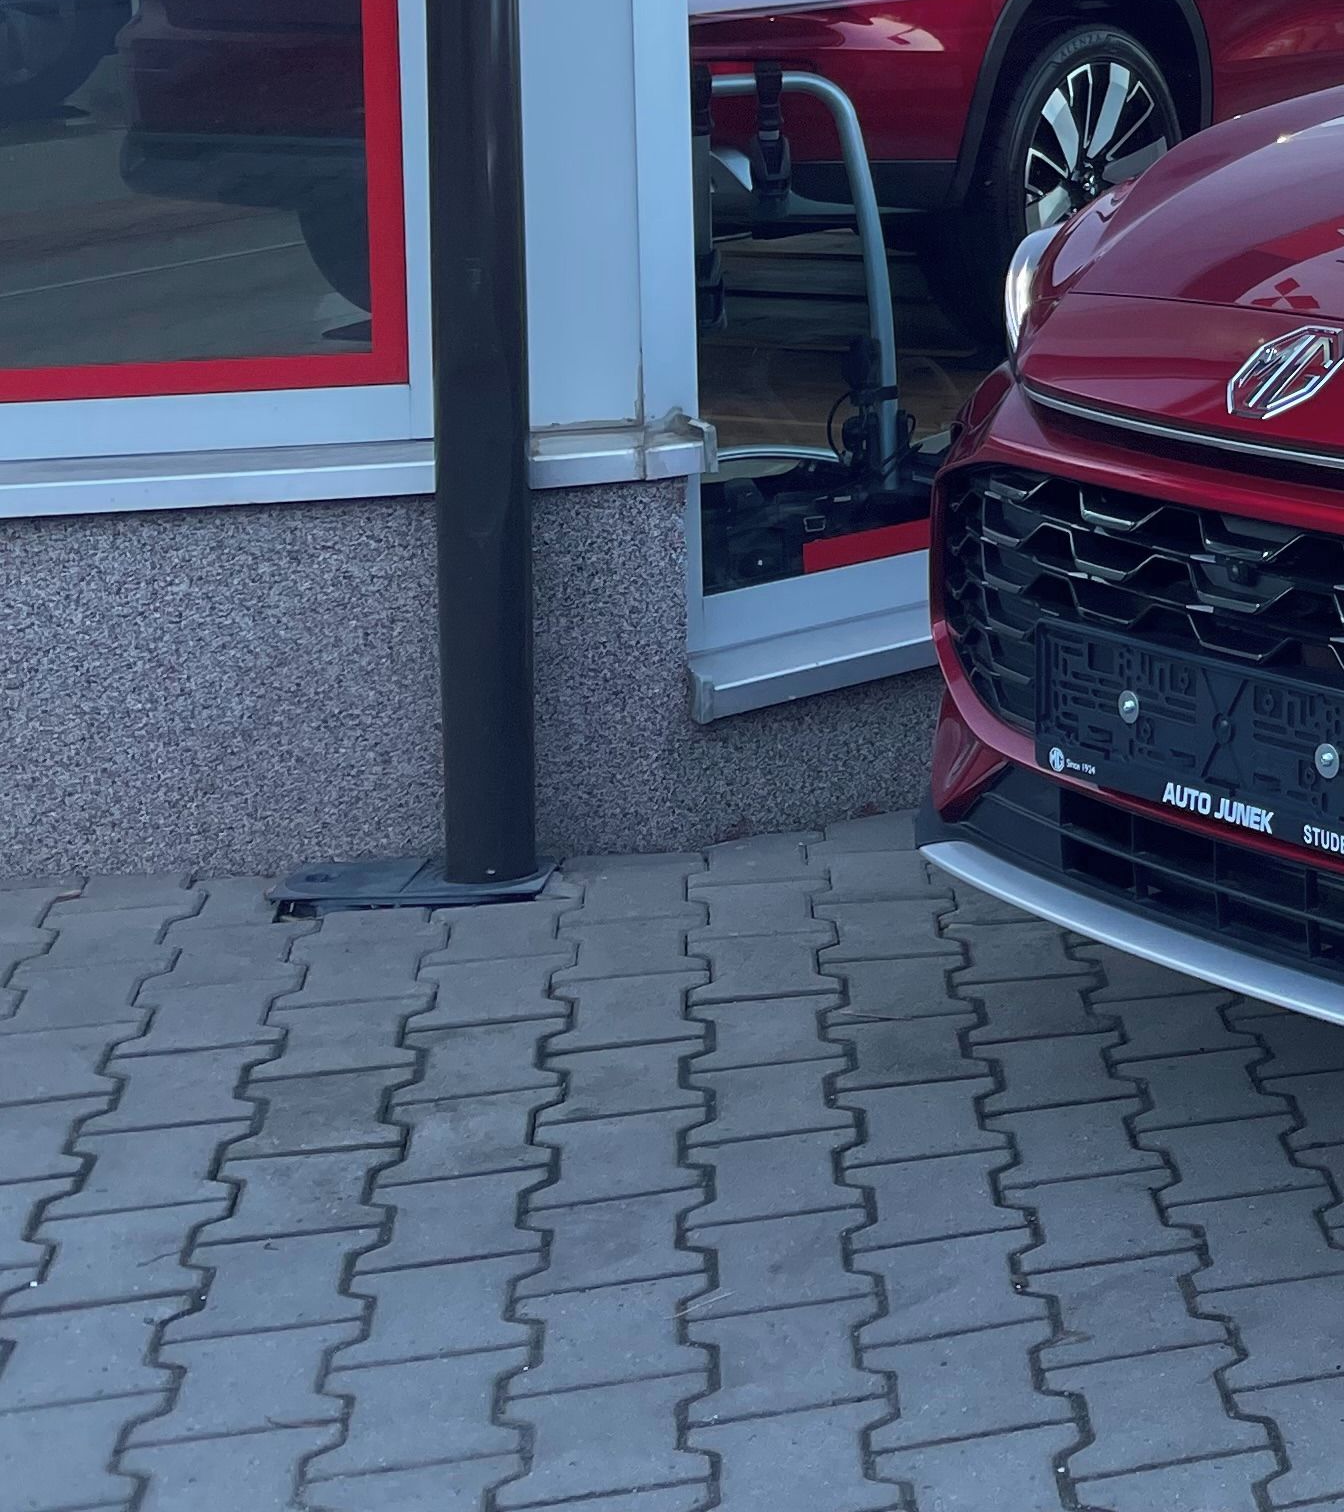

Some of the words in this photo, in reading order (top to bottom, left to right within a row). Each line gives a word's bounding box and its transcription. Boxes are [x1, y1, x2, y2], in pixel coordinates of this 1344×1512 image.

[1232, 329, 1341, 414] MG
[1049, 748, 1064, 771] MG
[1162, 782, 1211, 815] AUTO
[1214, 797, 1274, 835] JUNEK
